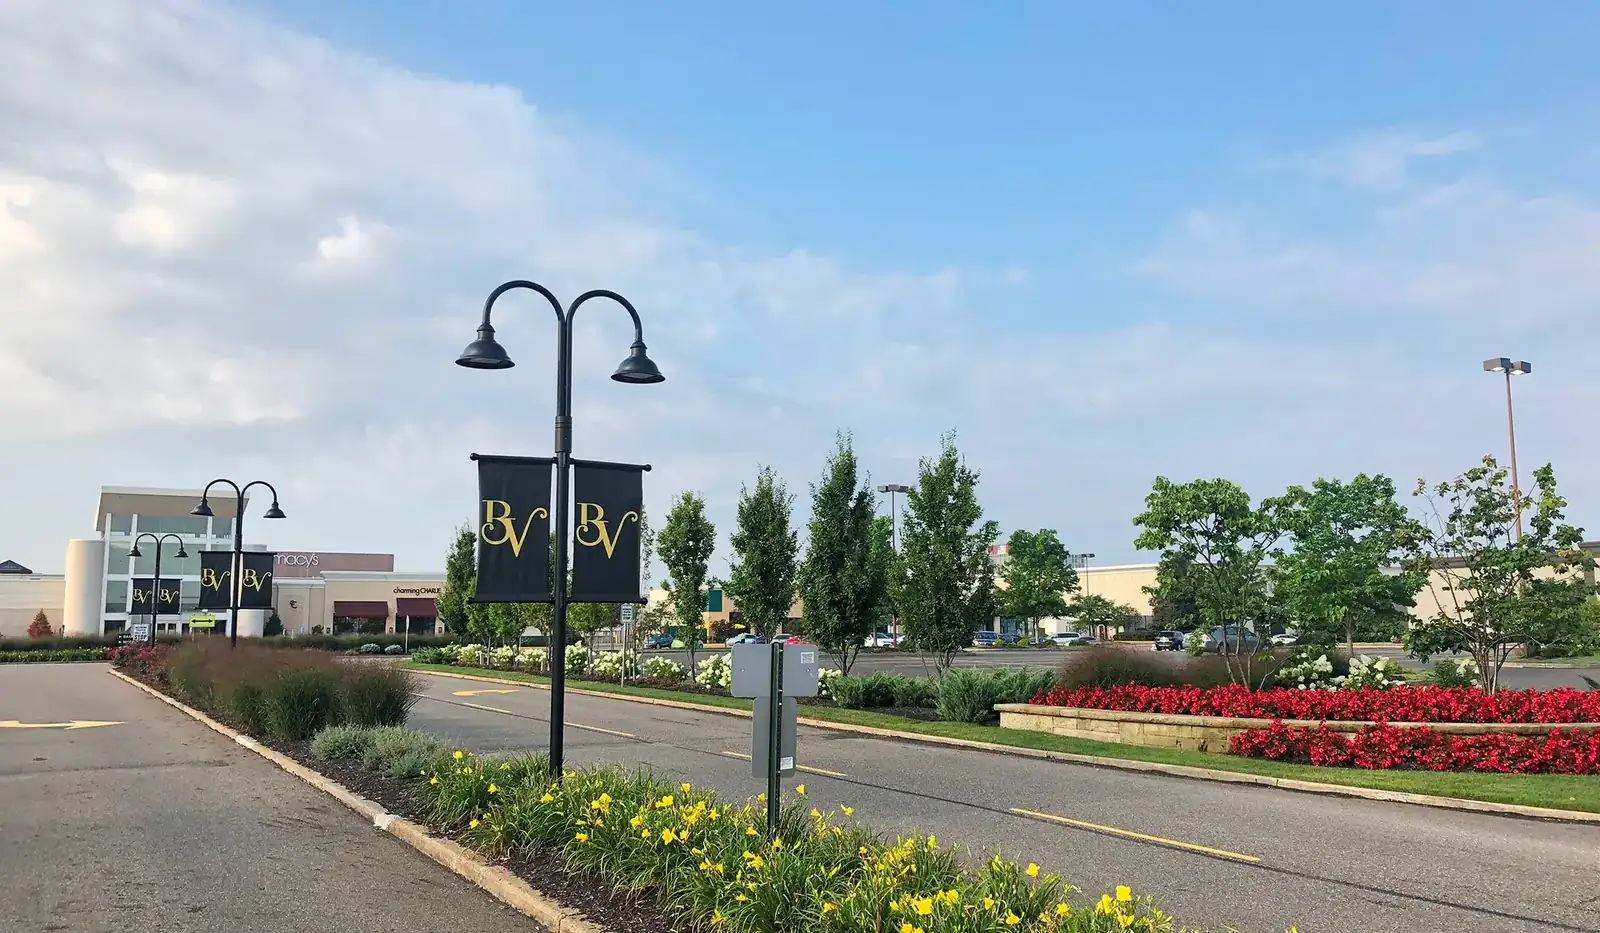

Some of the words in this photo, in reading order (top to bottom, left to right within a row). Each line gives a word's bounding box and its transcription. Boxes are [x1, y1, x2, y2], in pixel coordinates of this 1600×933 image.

[481, 500, 548, 558] BV
[576, 502, 638, 559] BV
[201, 568, 231, 591] BV
[243, 568, 272, 592] BV
[133, 588, 152, 604] BV
[159, 588, 179, 604] BV
